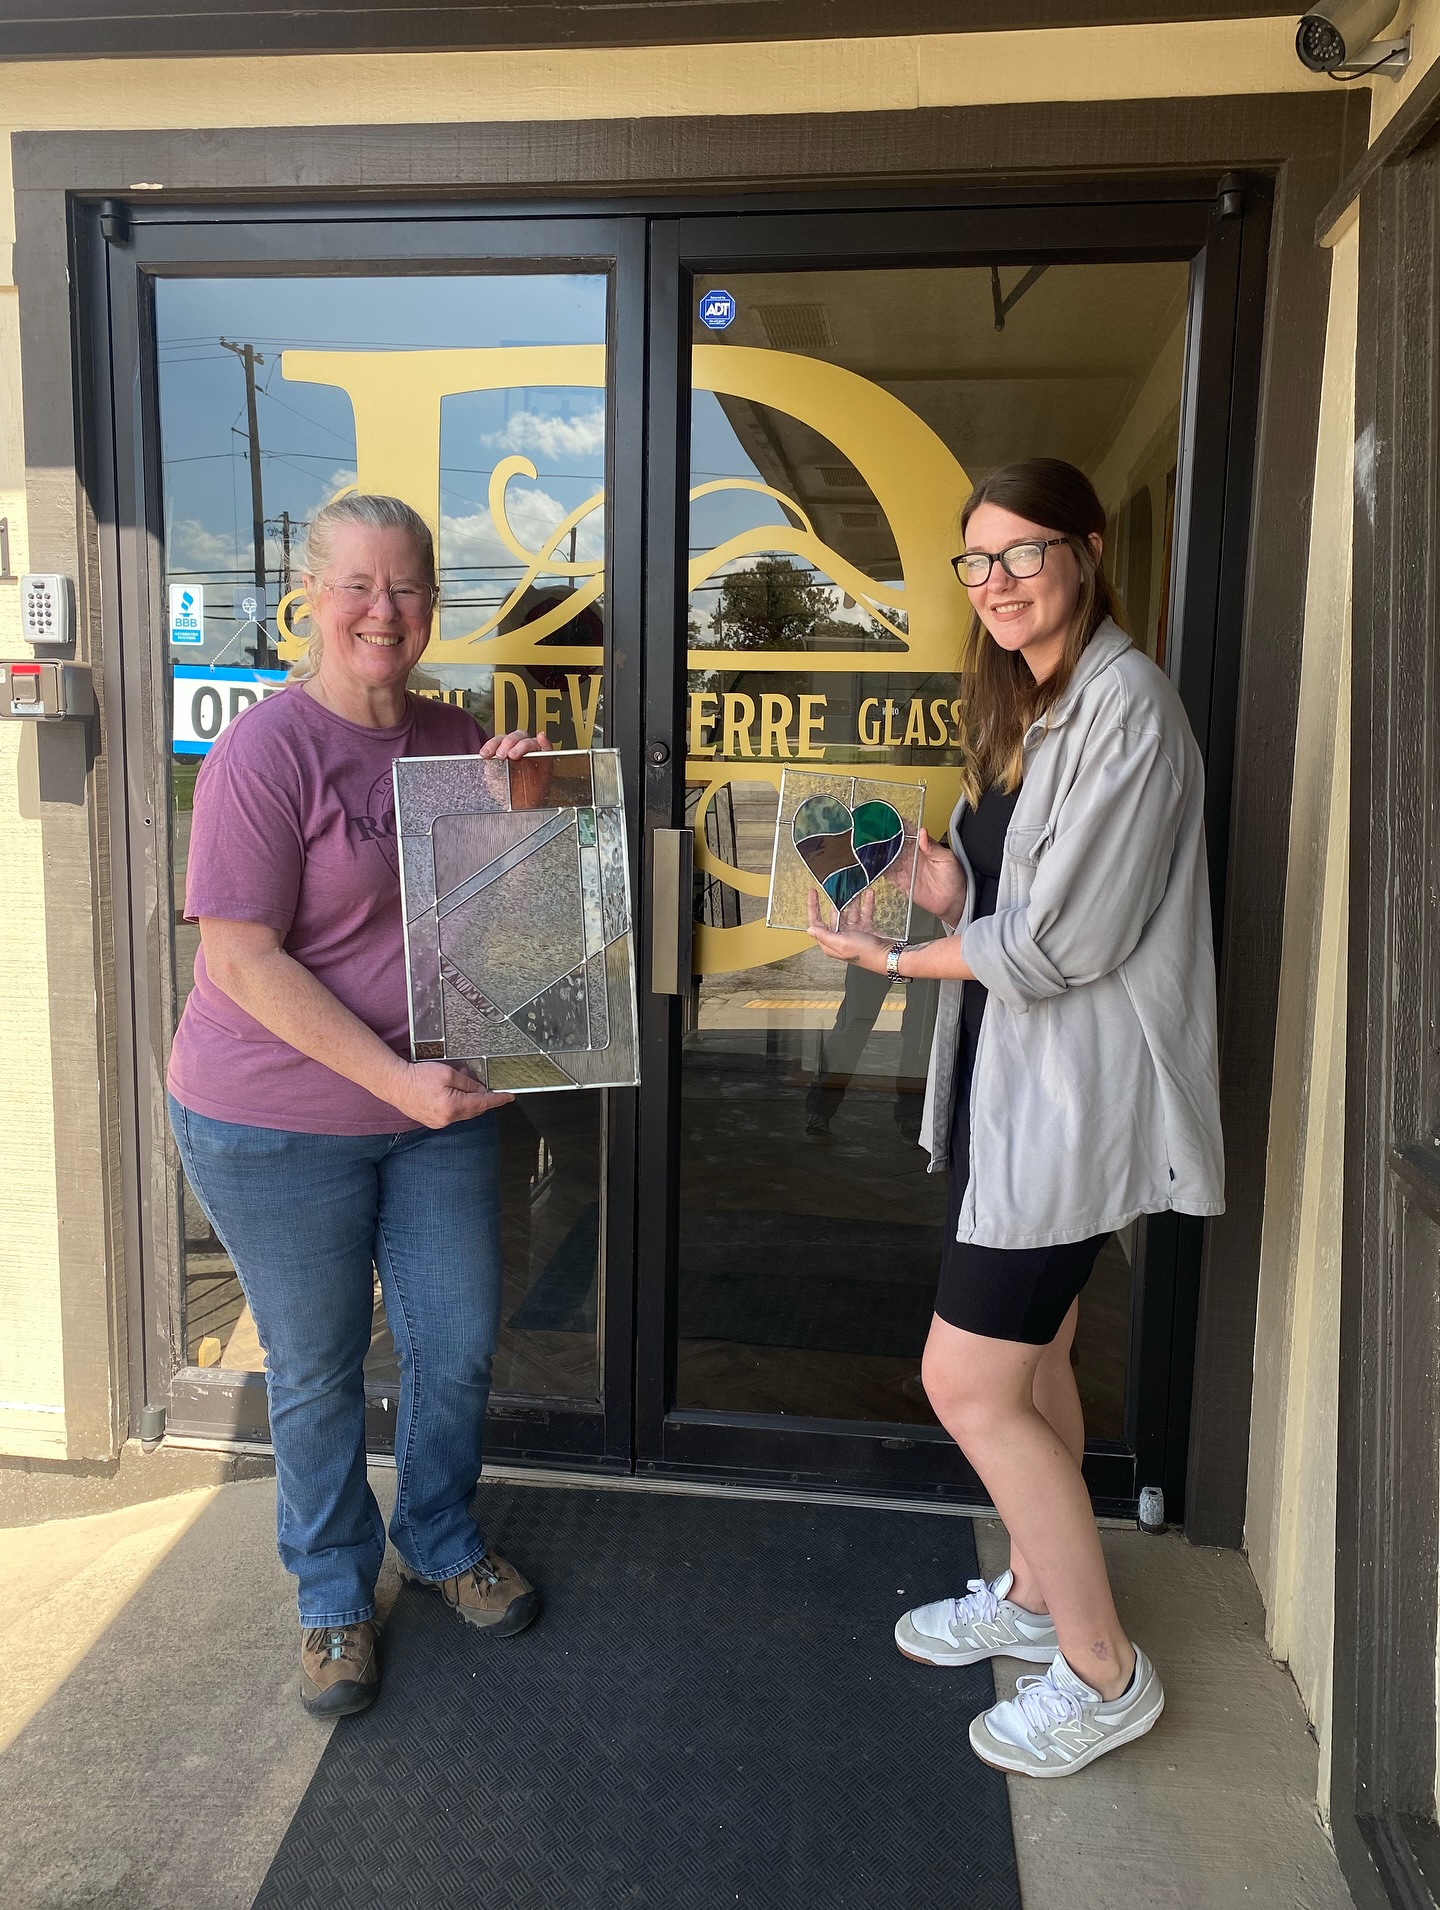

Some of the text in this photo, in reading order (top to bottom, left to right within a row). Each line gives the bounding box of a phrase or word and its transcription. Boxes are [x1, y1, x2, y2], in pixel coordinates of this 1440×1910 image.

[705, 302, 730, 316] ADT
[175, 618, 197, 627] BBB
[858, 697, 967, 747] GLASS
